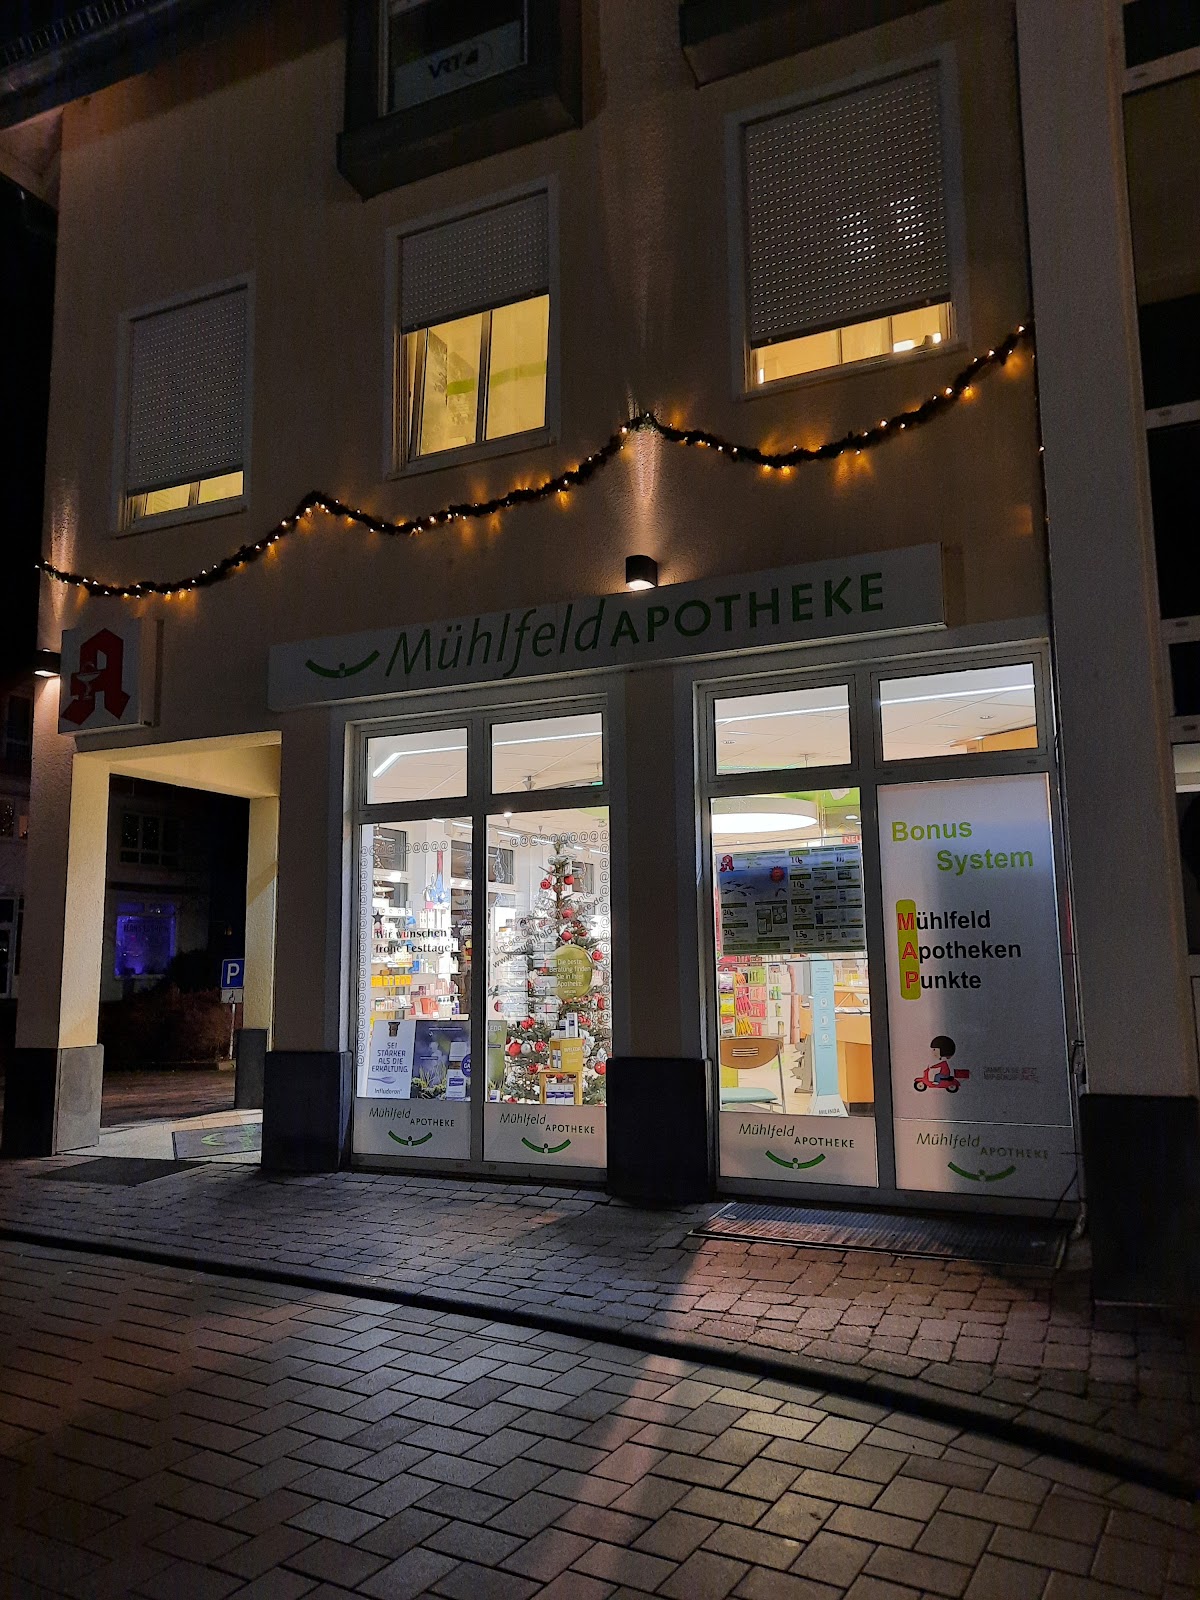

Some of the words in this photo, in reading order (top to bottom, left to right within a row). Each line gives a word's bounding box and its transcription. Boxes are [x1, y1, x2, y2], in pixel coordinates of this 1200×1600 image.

[384, 598, 606, 678] Mühlfeld
[610, 572, 884, 647] APOTHEKE
[891, 821, 973, 842] Bonus
[936, 848, 1034, 876] System
[896, 909, 991, 931] Mühlfeld
[396, 928, 447, 938] wünschen
[901, 939, 1022, 963] Apotheken
[226, 963, 240, 985] P
[905, 970, 982, 990] Punkte
[368, 1107, 411, 1121] Mühlfeld
[410, 1117, 455, 1127] APOTHEKE
[499, 1112, 547, 1127] Mühlfeld
[545, 1123, 595, 1135] APOTHEKE
[738, 1123, 795, 1139] Mühlfeld
[794, 1136, 856, 1149] APOTHEKE
[916, 1132, 981, 1149] Mühlfeld
[979, 1147, 1049, 1160] APOTHEKE
